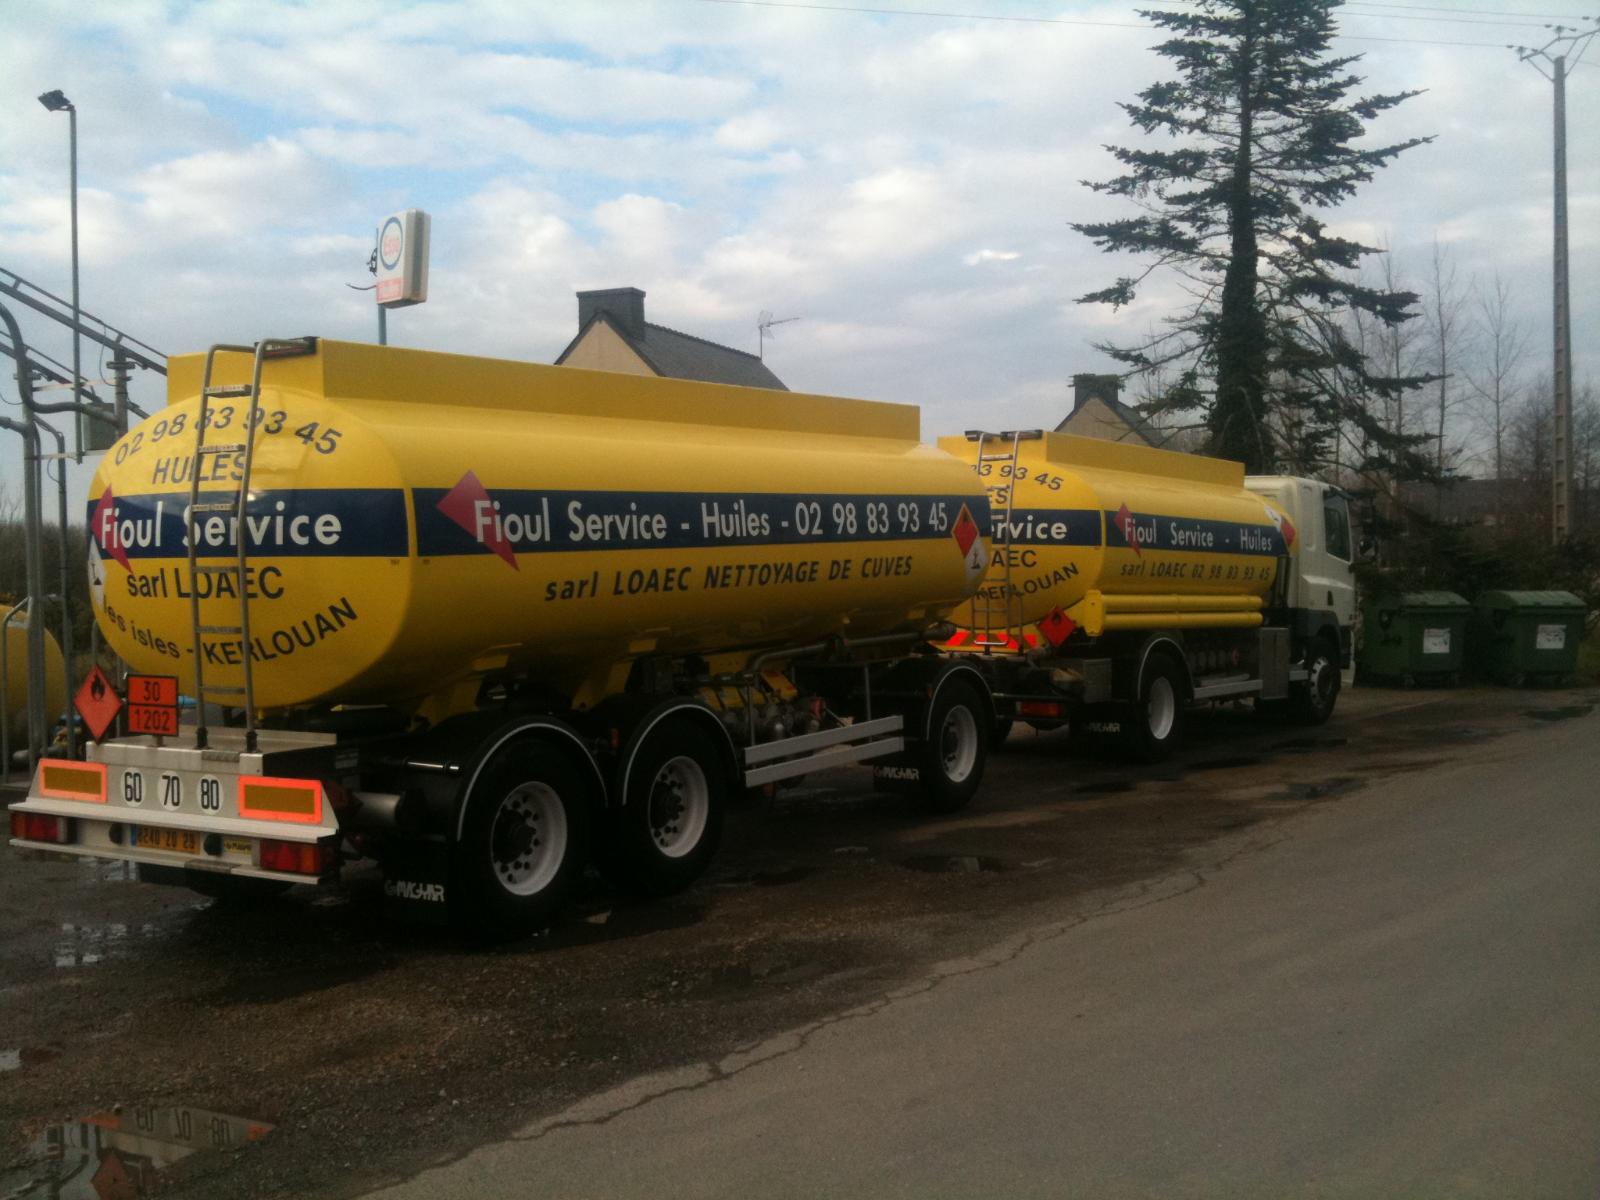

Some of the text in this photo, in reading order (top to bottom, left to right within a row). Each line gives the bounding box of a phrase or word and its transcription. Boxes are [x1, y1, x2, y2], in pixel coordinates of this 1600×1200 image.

[115, 432, 145, 466] 02
[151, 413, 187, 442] 98
[243, 406, 287, 434] 93
[295, 421, 342, 454] 45
[1000, 464, 1028, 480] 93
[1035, 473, 1064, 490] 45
[101, 500, 342, 550] Fioul Service
[474, 497, 551, 543] Fioul
[569, 500, 667, 541] Service
[702, 499, 770, 538] Huiles
[796, 503, 823, 536] 02
[832, 503, 857, 535] 98
[868, 503, 889, 534] 83
[899, 503, 920, 533] 93
[929, 502, 948, 532] 45
[1124, 517, 1157, 544] Fioul
[1171, 520, 1214, 547] Service
[1240, 527, 1272, 551] Huiles
[127, 566, 284, 599] sarl LOAEC
[544, 556, 912, 602] sarl LOAEC NETTOYAGE DE CUVES
[1120, 560, 1146, 577] sarl
[1150, 562, 1187, 578] LOAEC
[131, 620, 180, 658] isles
[203, 597, 357, 665] KERLOUAN
[143, 681, 160, 701] 30
[134, 709, 171, 732] 1202
[124, 772, 219, 810] 60 70 80
